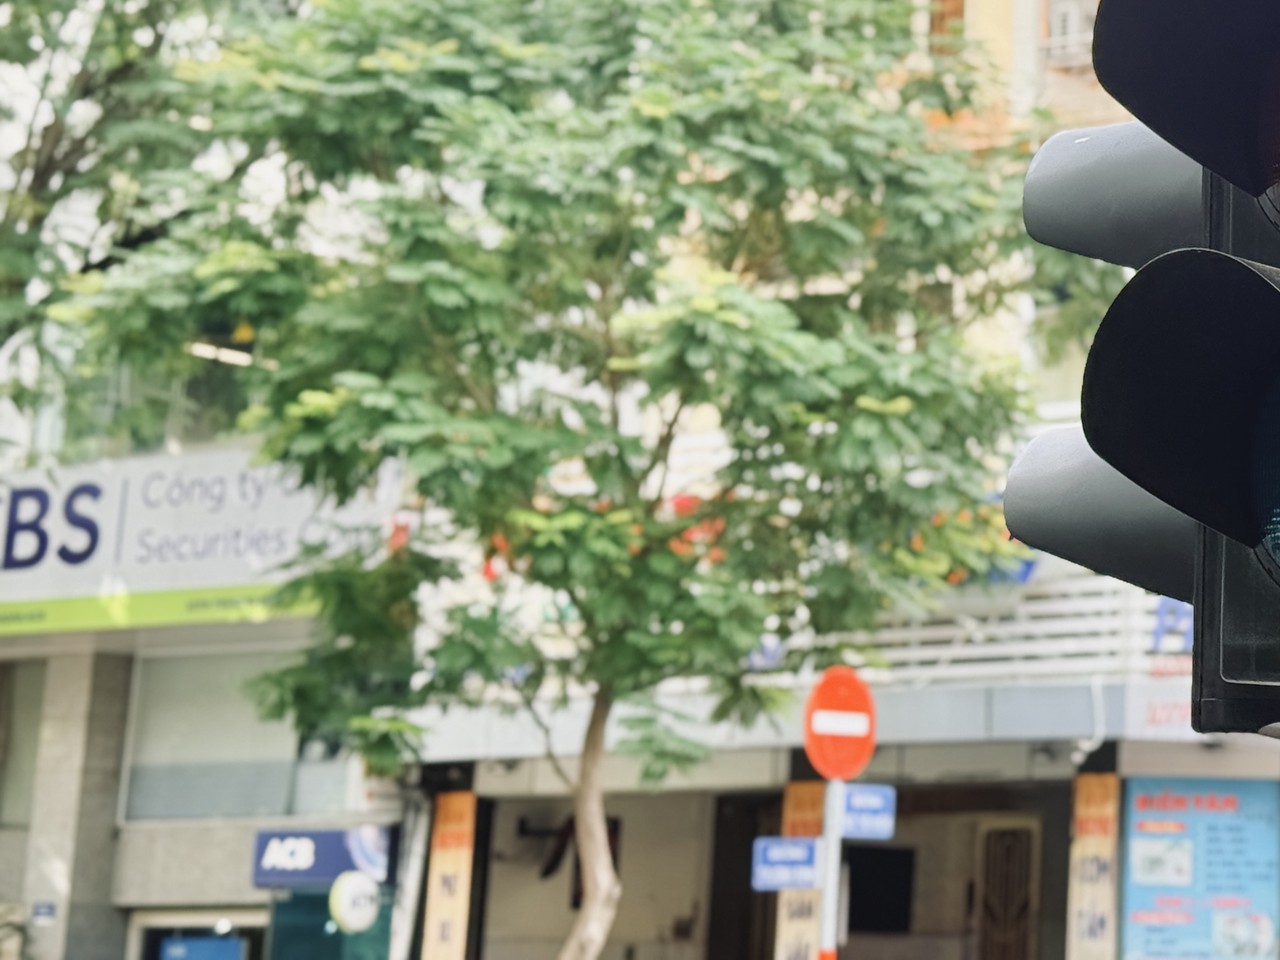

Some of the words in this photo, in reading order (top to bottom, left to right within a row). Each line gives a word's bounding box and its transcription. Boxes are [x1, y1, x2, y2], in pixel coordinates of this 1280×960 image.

[141, 470, 231, 514] Công
[0, 482, 103, 570] BS
[136, 524, 289, 565] Securities
